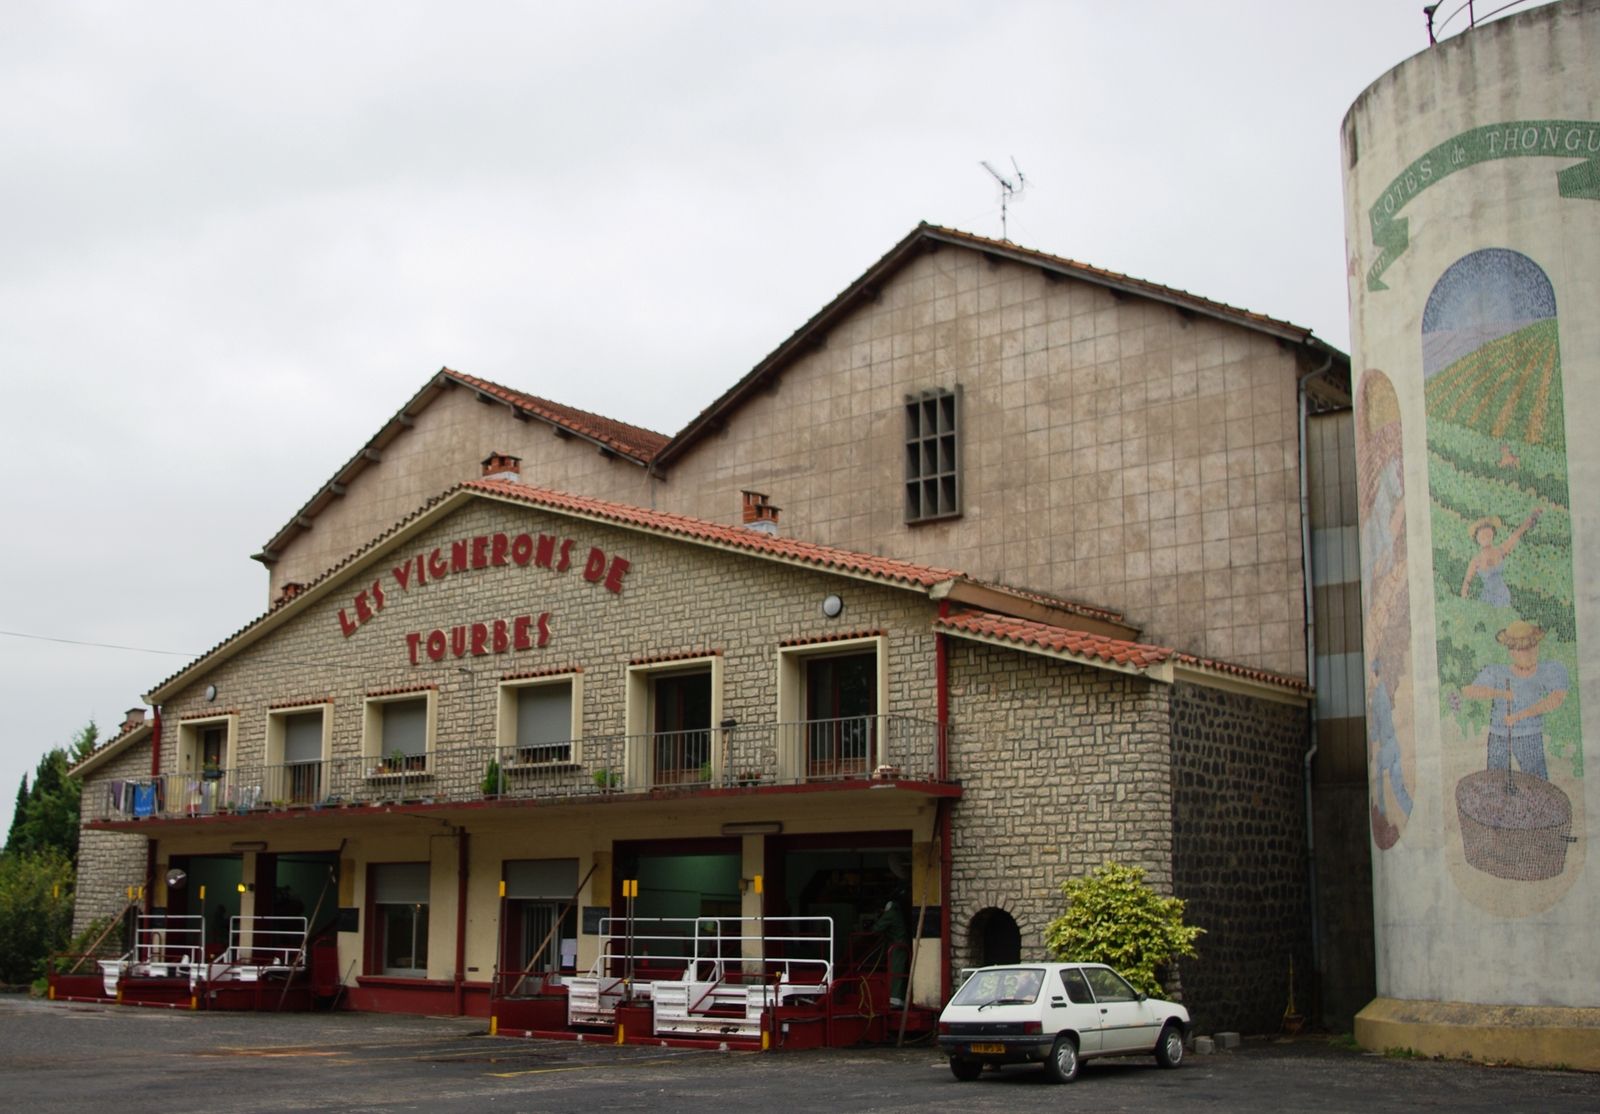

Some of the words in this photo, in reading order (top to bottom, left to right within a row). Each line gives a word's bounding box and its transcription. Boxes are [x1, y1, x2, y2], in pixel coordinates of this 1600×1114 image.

[1374, 160, 1432, 226] COTES
[1450, 145, 1465, 165] de
[337, 579, 385, 638] LES
[392, 532, 575, 592] VIGNERONS
[583, 546, 631, 594] DE
[406, 612, 552, 665] TOURBES
